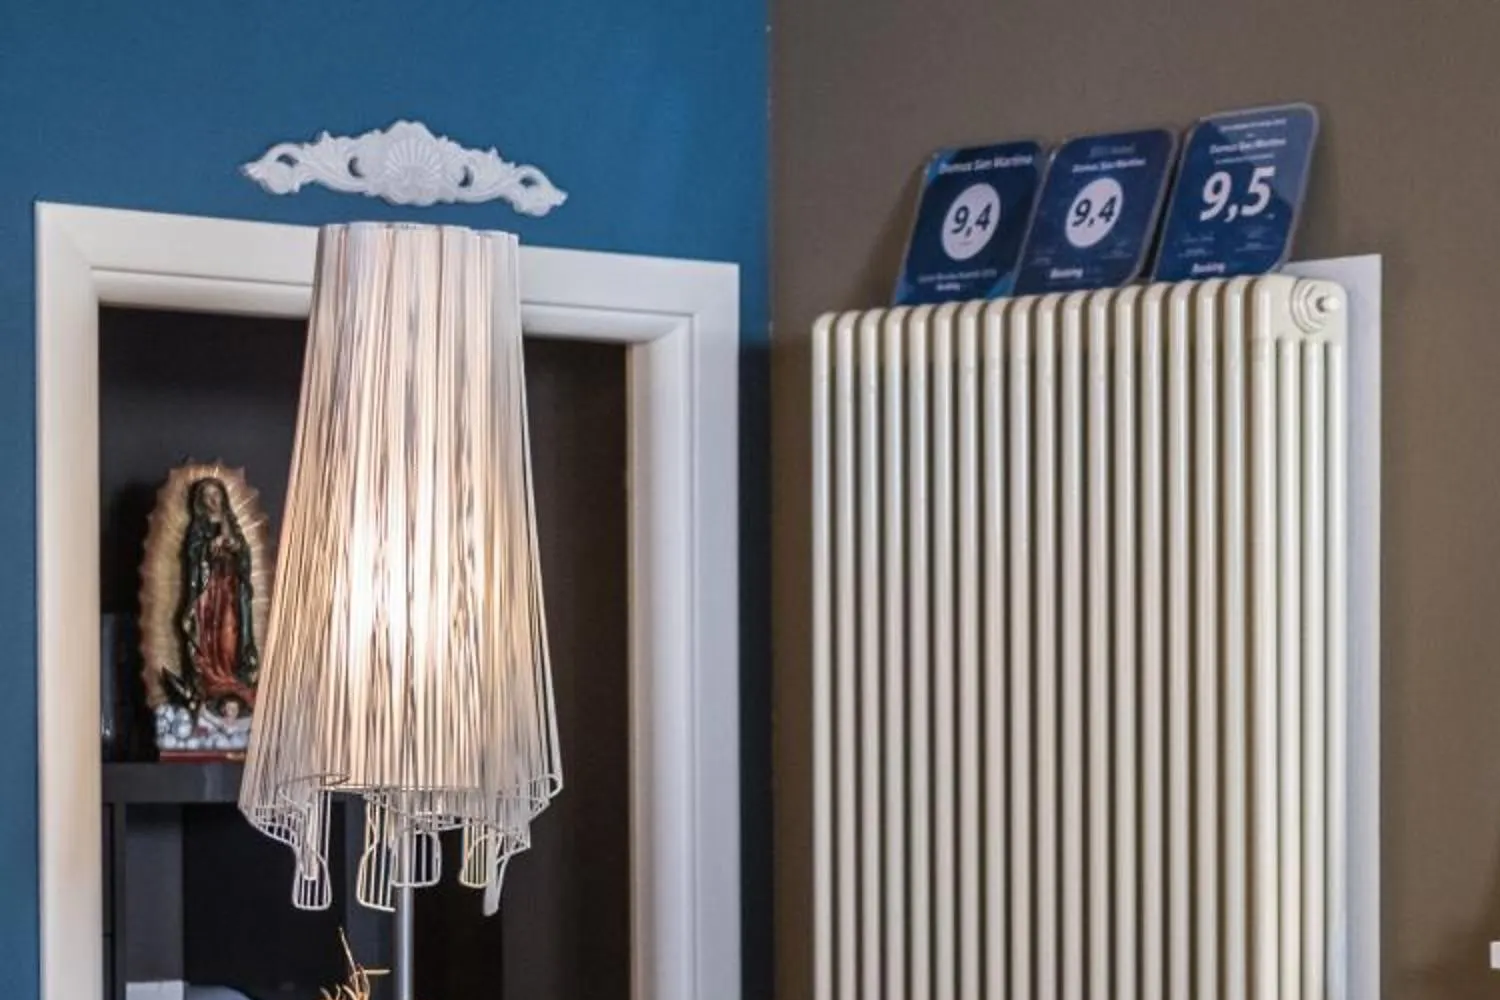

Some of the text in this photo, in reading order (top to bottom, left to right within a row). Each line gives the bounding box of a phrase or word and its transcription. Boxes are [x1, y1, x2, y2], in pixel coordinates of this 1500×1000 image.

[1199, 165, 1276, 223] 9,5
[951, 203, 993, 238] 9,4
[1071, 196, 1117, 228] 9,4
